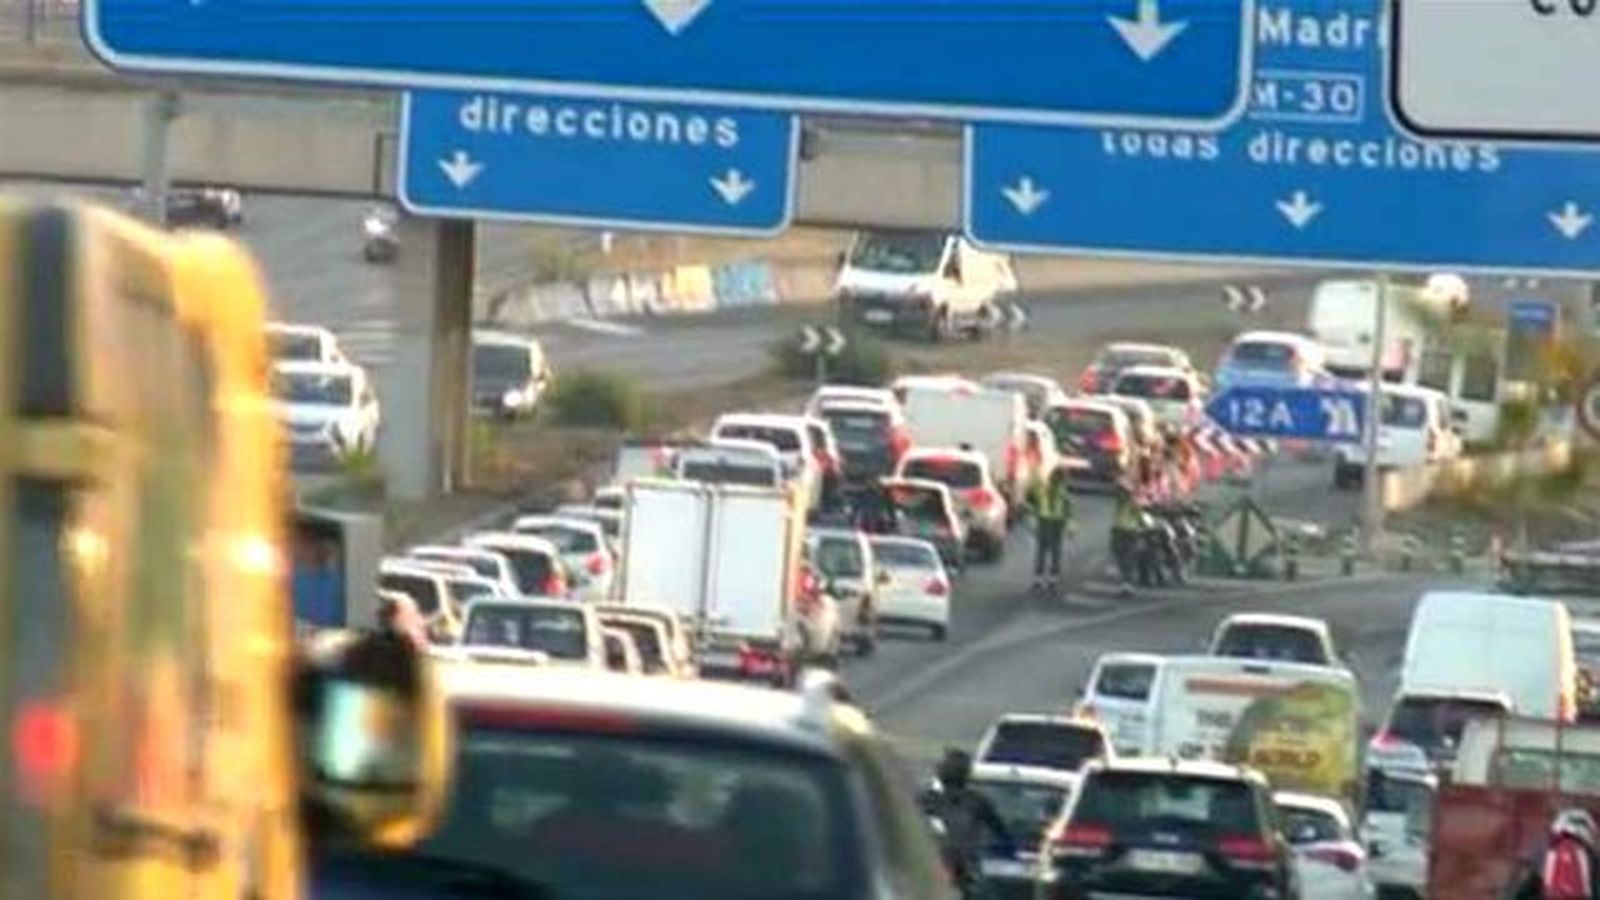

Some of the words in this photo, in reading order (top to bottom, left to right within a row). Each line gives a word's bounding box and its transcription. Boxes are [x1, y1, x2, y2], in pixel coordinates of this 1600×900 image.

[1258, 6, 1388, 46] Madr
[459, 96, 739, 147] direcciones
[1249, 132, 1501, 171] direcciones
[1229, 397, 1295, 428] 12A
